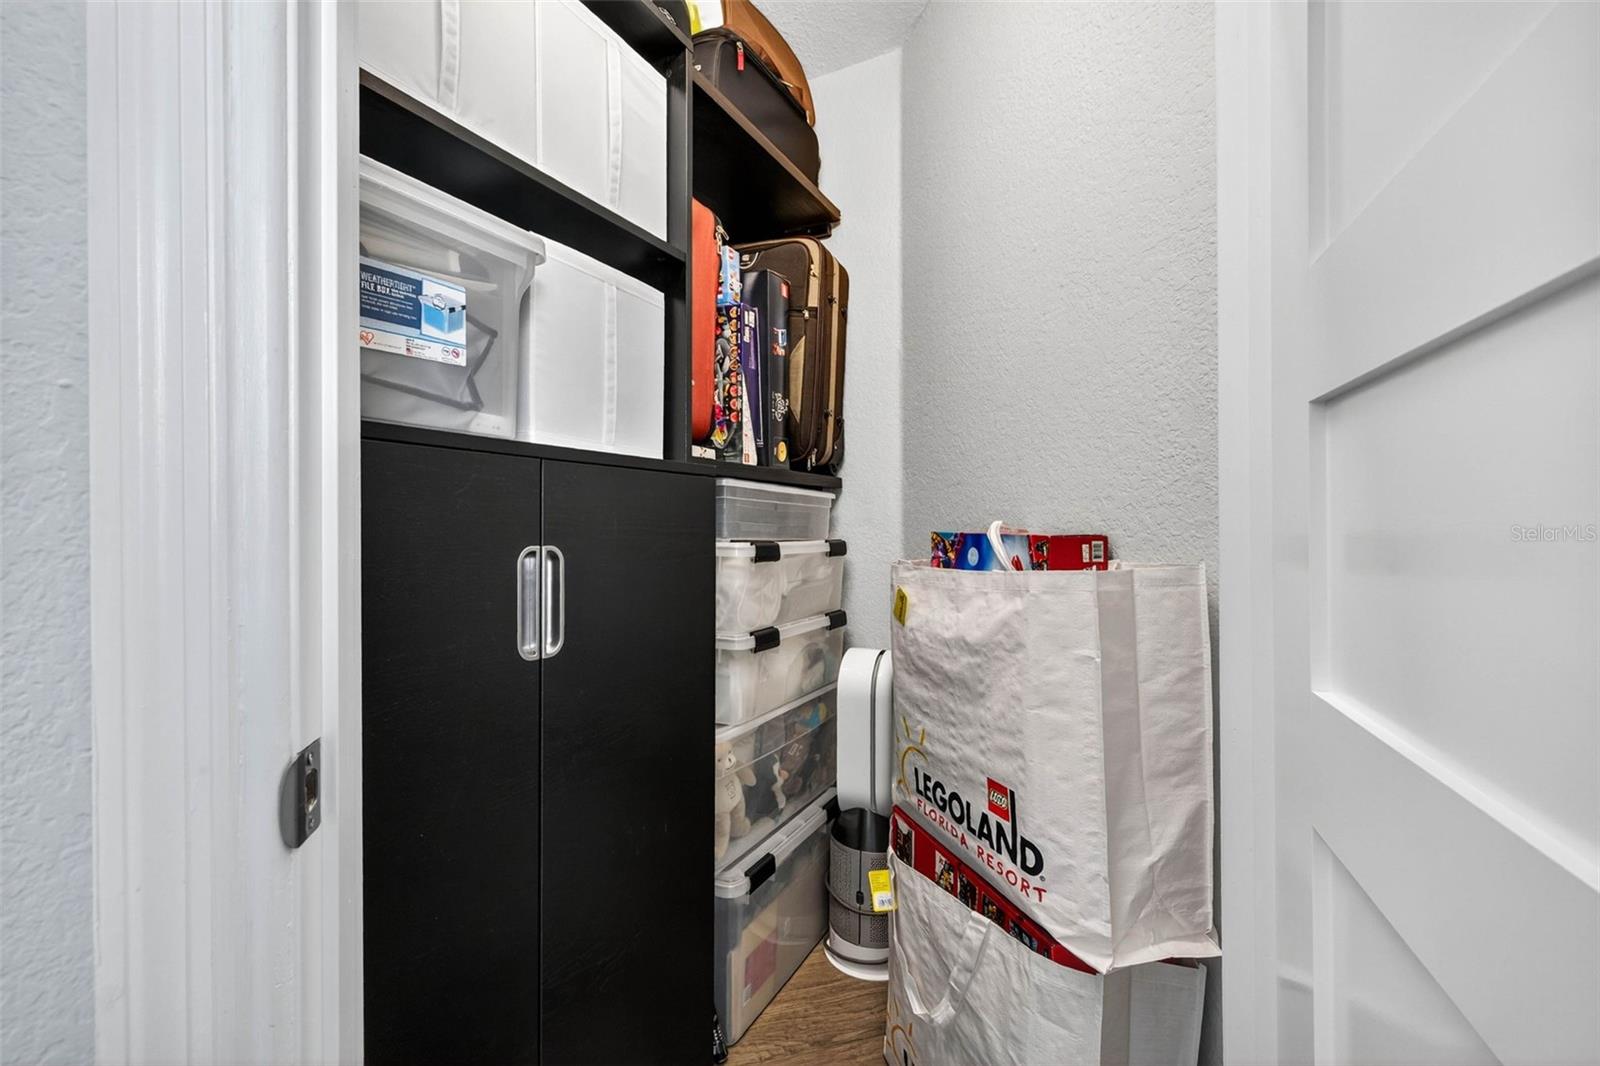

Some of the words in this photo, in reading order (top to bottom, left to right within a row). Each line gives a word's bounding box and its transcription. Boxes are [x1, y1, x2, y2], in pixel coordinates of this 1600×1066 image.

[914, 767, 1044, 877] LEGOLAND
[916, 799, 969, 849] FLORIDA
[976, 846, 1047, 902] RESORT
